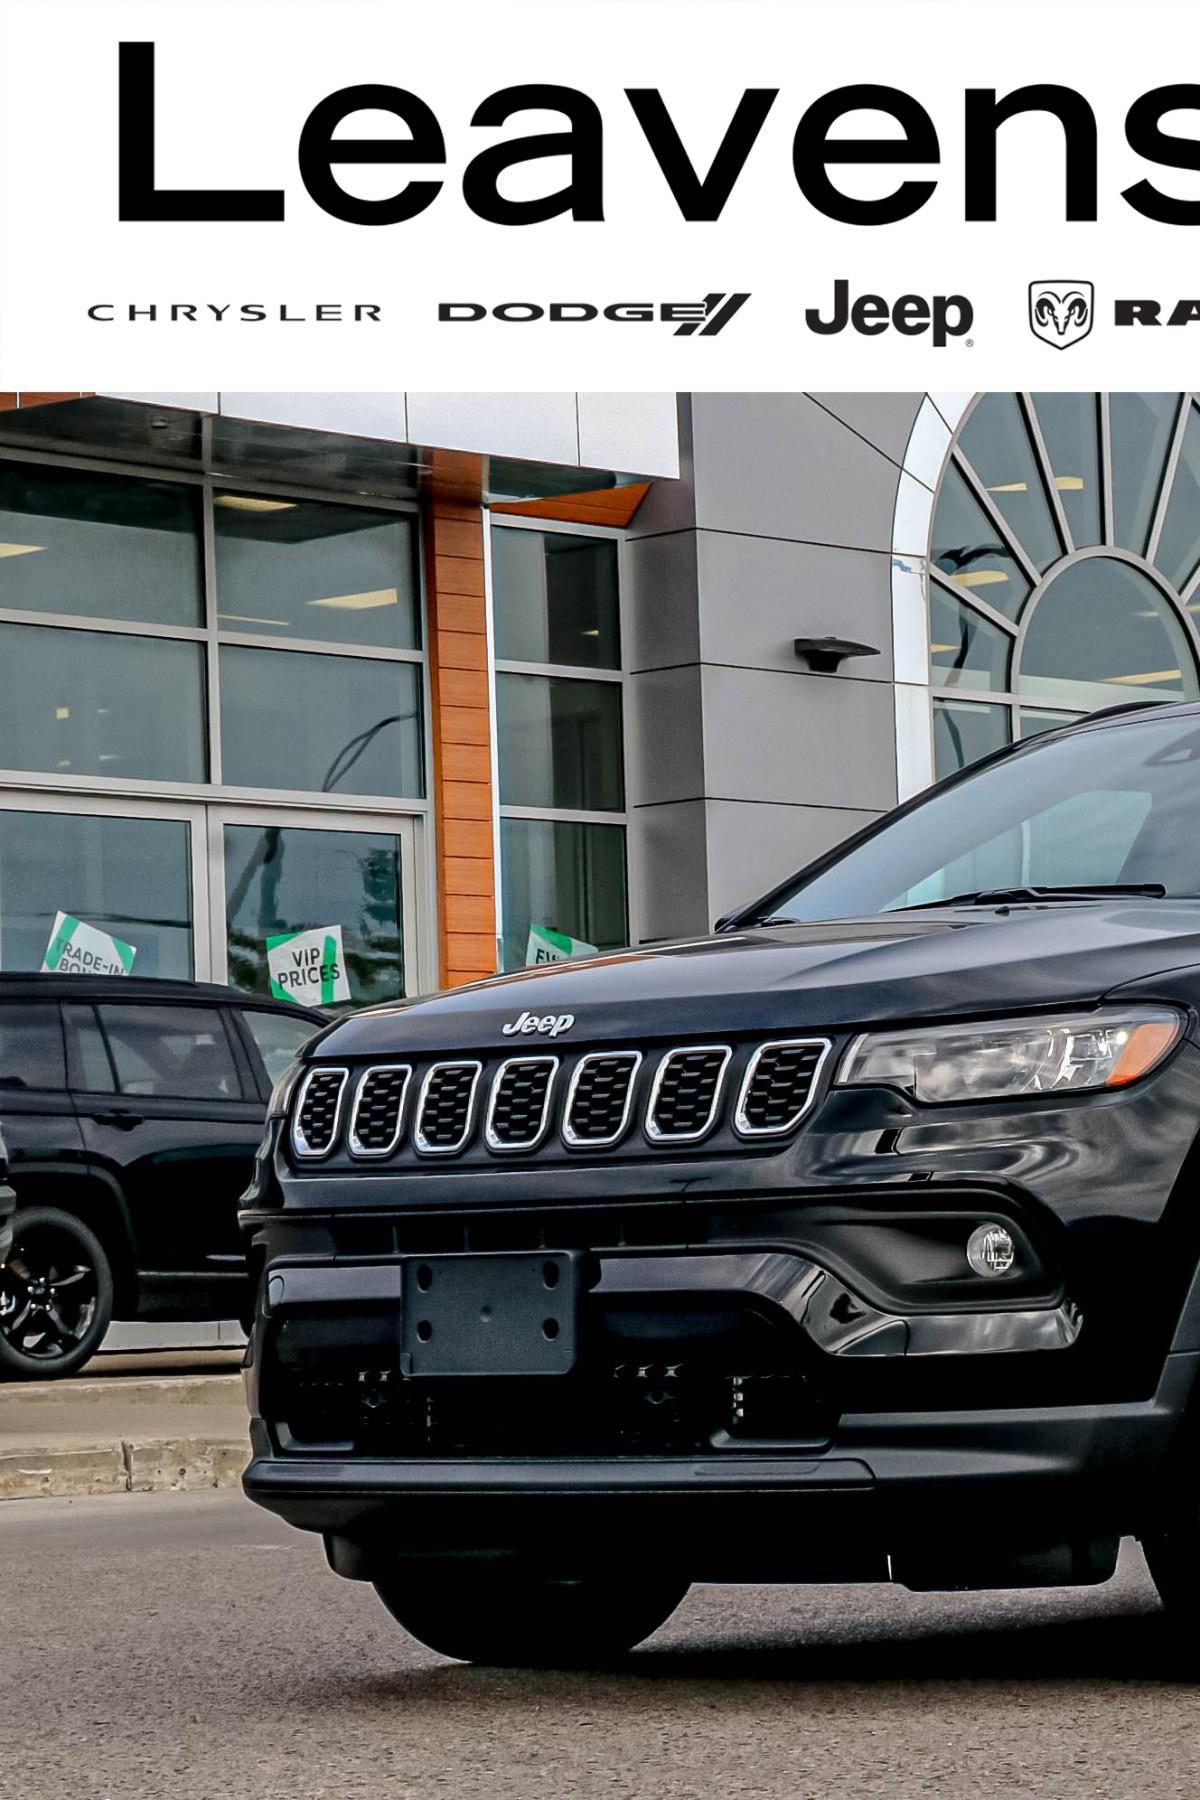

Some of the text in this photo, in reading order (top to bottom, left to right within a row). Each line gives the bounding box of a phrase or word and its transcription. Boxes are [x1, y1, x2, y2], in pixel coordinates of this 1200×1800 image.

[292, 947, 320, 967] VIP
[278, 963, 340, 989] PRICES
[502, 1011, 575, 1038] Jeep
